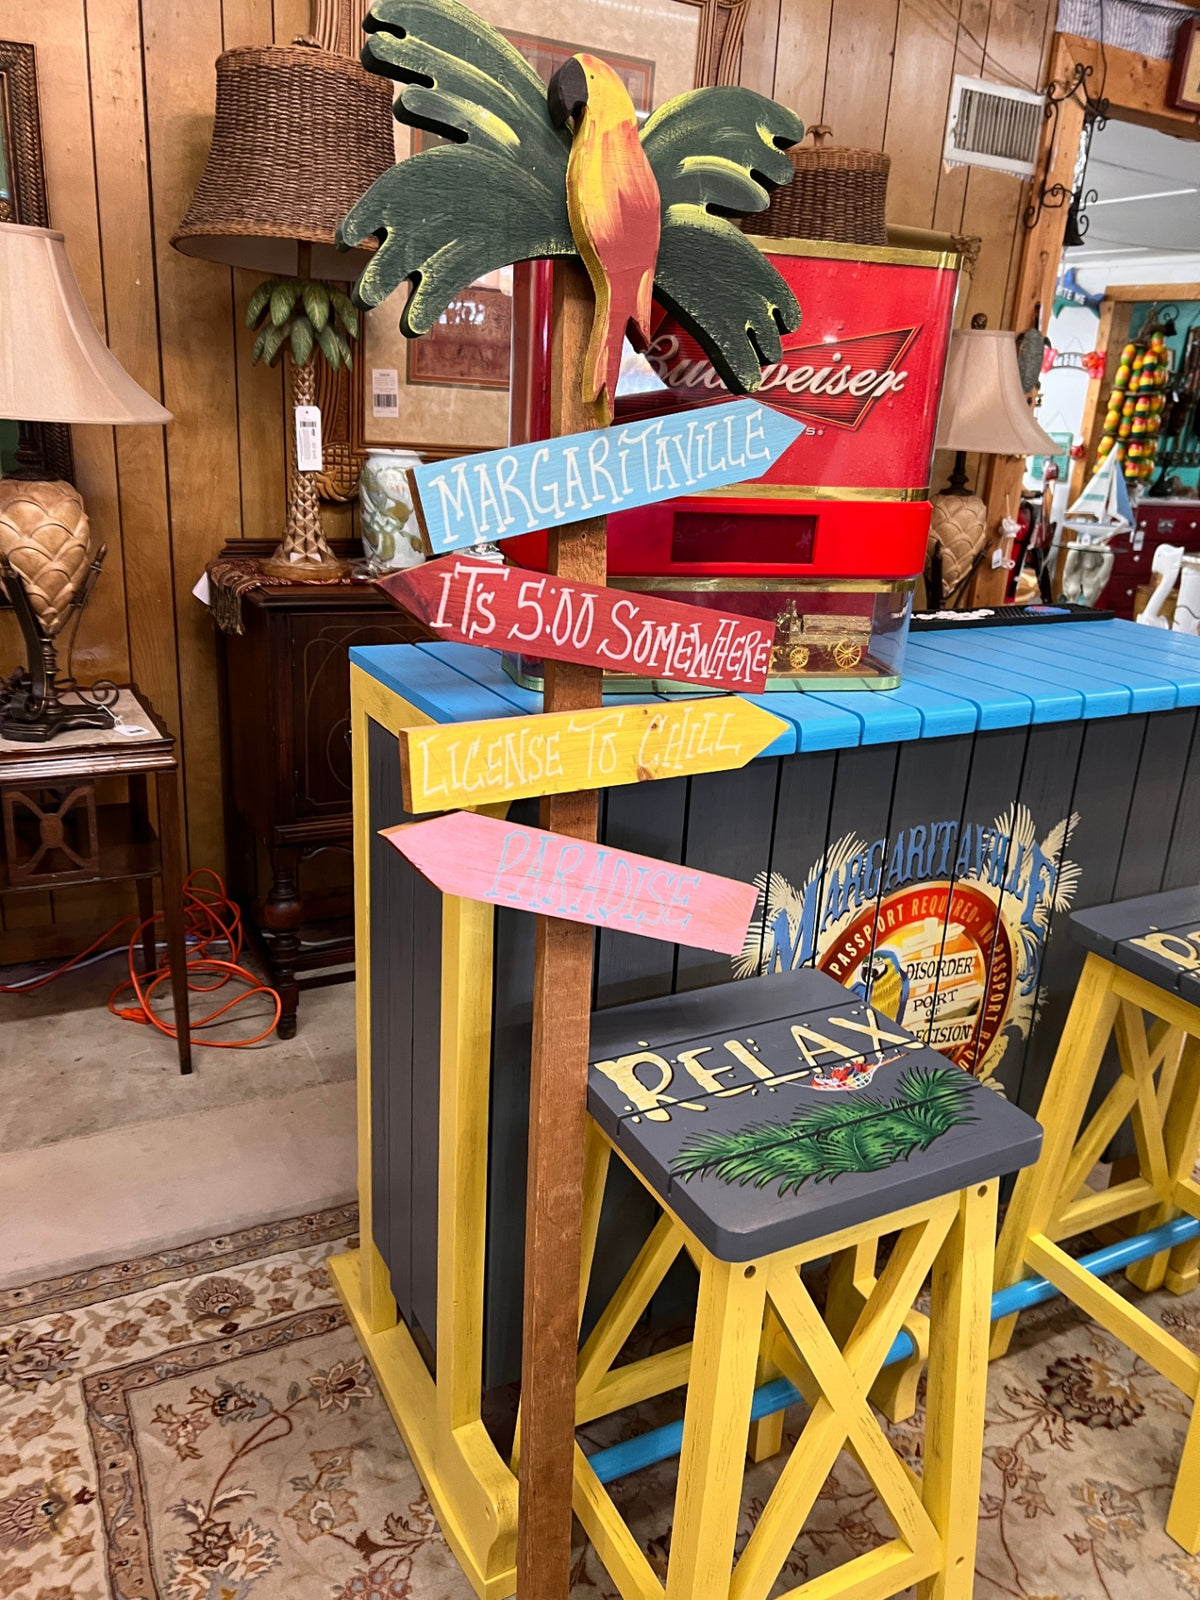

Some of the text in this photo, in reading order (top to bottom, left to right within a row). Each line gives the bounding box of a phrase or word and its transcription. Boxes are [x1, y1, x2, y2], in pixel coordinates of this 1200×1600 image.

[428, 408, 771, 544] MARGARITAVILLE
[507, 577, 599, 649] 5:00
[417, 707, 743, 798] LICENSE TO CHILL
[485, 830, 700, 931] PARADISE
[767, 820, 1057, 974] MARGARITAVILLE
[829, 903, 904, 976] PASSPORT
[985, 943, 1008, 1022] PASSPORT
[906, 956, 974, 981] DISORDER
[913, 989, 959, 1012] PORT
[925, 1008, 941, 1017] OF
[594, 1008, 925, 1122] RELAX
